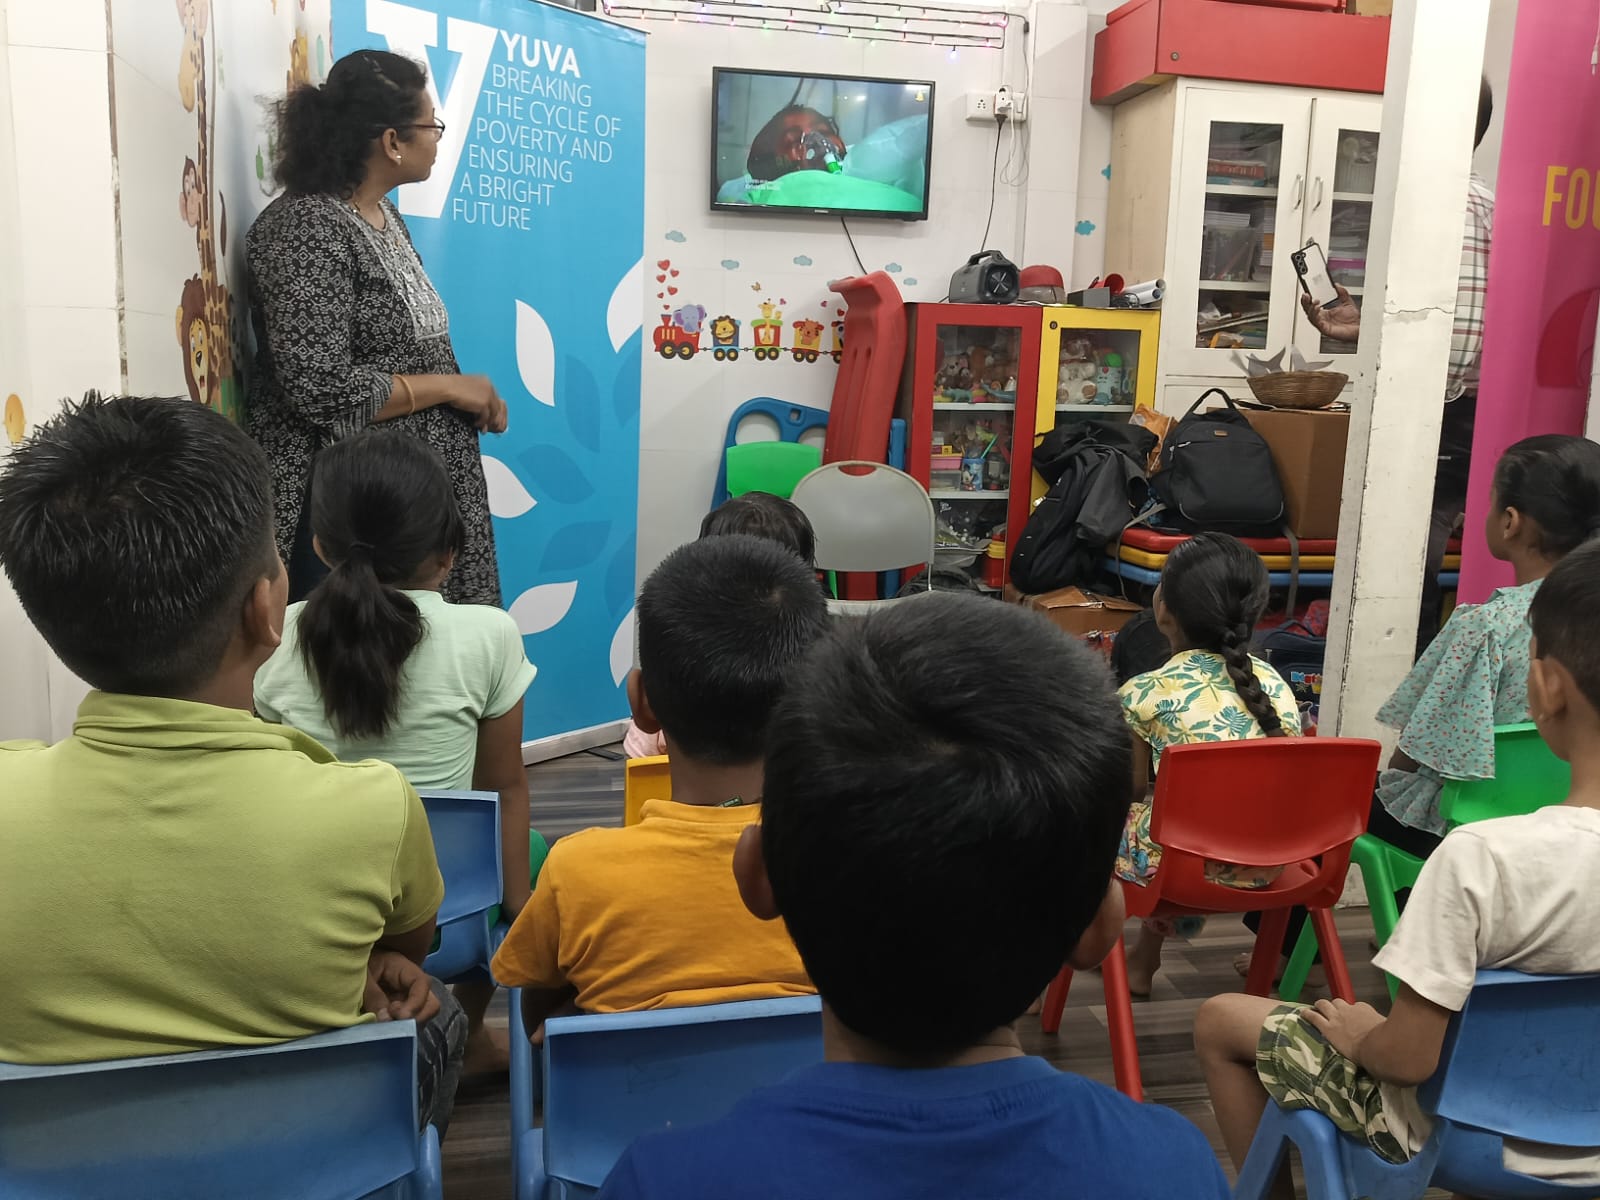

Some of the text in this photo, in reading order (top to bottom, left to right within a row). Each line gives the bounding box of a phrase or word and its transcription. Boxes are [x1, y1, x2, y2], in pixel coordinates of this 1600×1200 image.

[500, 30, 581, 78] YUVA
[492, 63, 592, 107] BREAKING
[483, 89, 622, 138] THE CYCLE OF
[476, 117, 613, 164] POVERTY AND
[468, 143, 573, 183] ENSURING
[460, 172, 555, 207] A BRIGHT
[452, 198, 531, 231] FUTURE
